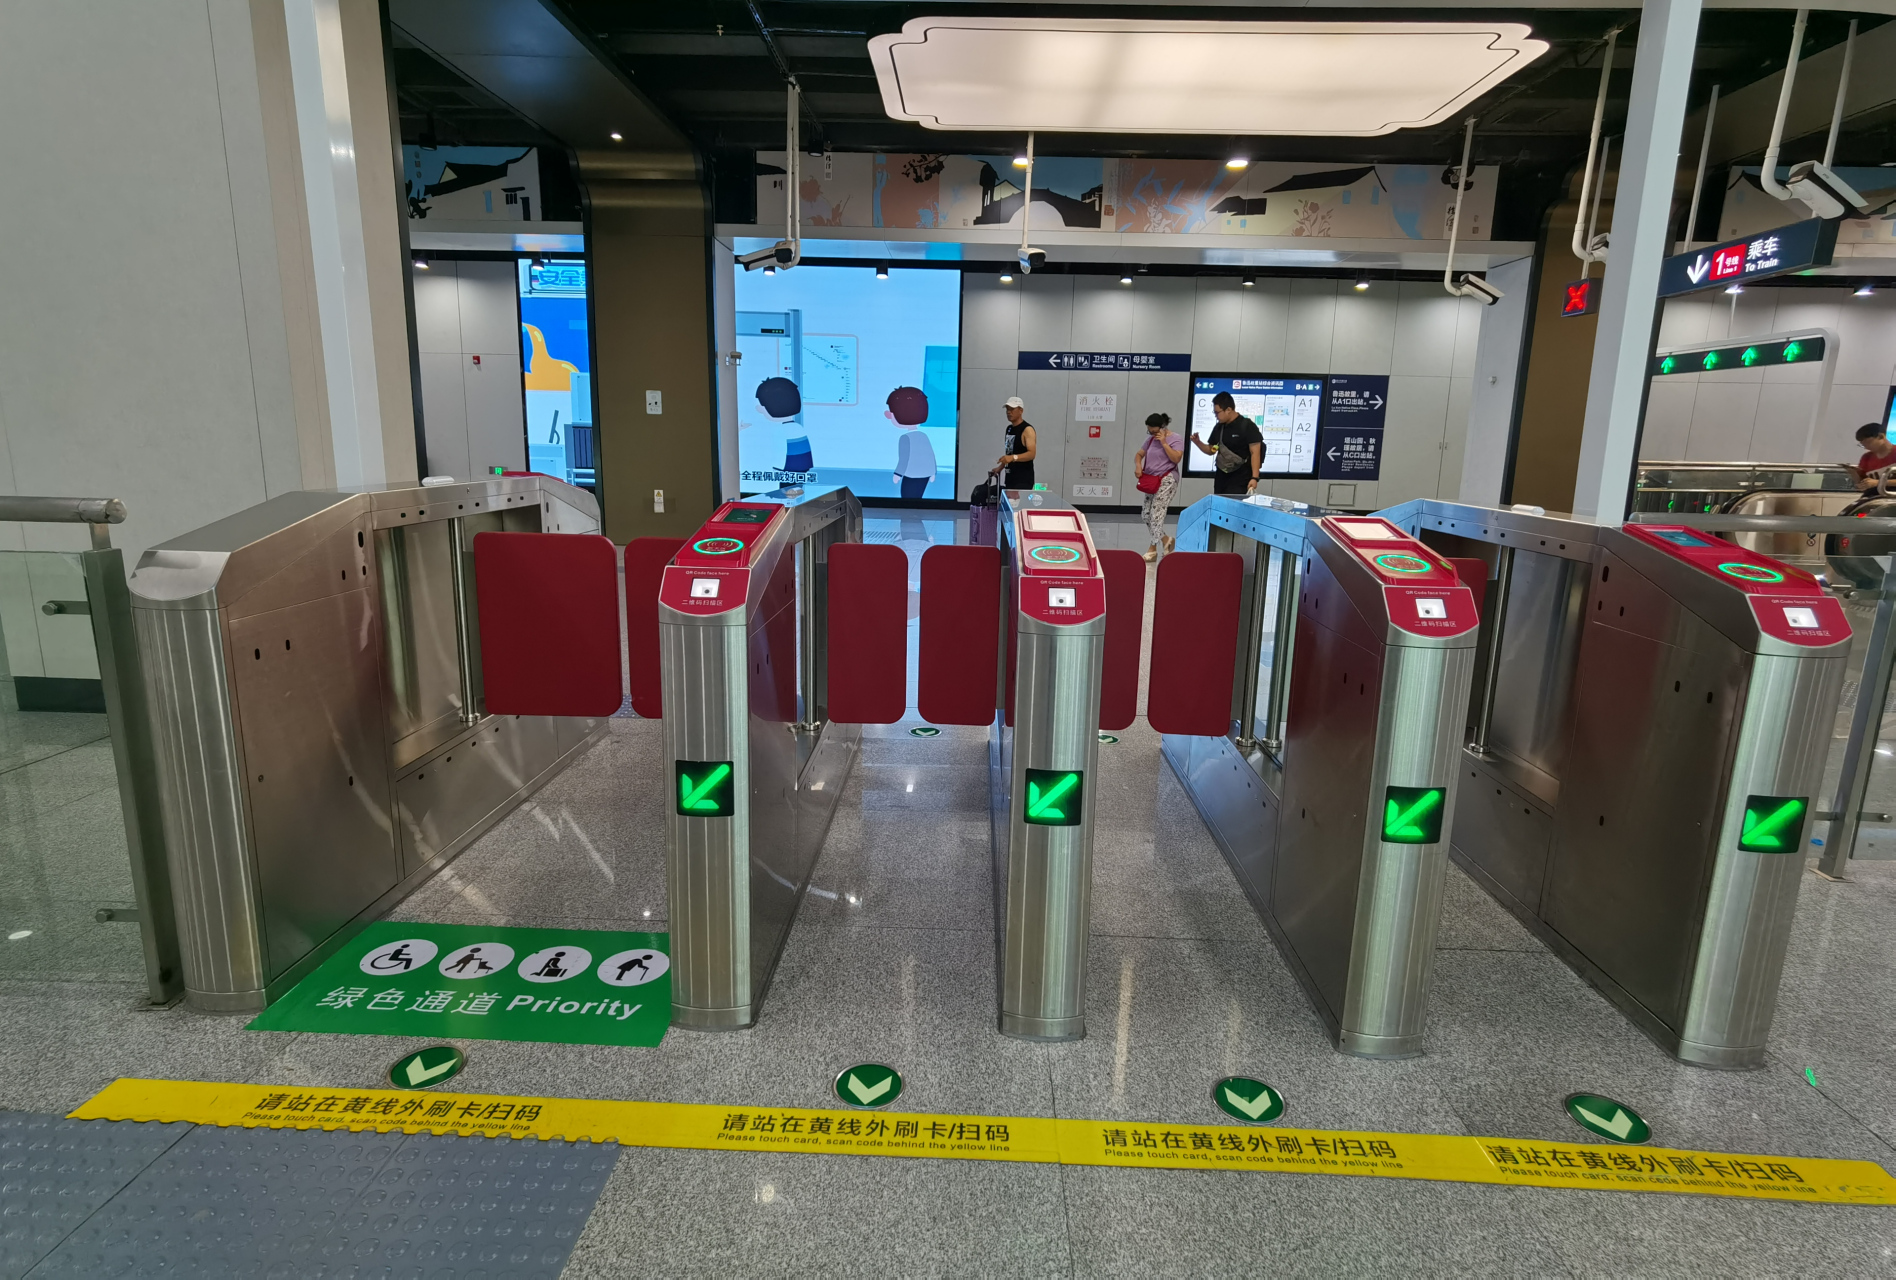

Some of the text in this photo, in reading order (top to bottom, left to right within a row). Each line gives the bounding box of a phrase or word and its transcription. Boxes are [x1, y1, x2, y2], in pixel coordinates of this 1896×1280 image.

[1746, 236, 1779, 260] 乘车
[1745, 258, 1779, 272] To Train
[1092, 354, 1115, 364] 卫生间
[1133, 355, 1155, 364] 母婴室
[1198, 398, 1206, 408] C
[1298, 399, 1313, 407] A1
[1296, 423, 1311, 431] A2
[1294, 445, 1302, 453] B
[741, 470, 818, 483] 全程佩戴好口罩
[1076, 487, 1109, 496] 灭火器
[316, 985, 643, 1020] 绿色通道 Priority
[254, 1092, 543, 1122] 请站在黄线外刷卡/扫码
[242, 1112, 281, 1120] Please
[284, 1114, 315, 1122] touch
[318, 1115, 345, 1123] card,
[410, 1119, 448, 1127] behind
[471, 1122, 508, 1130] yellow
[510, 1123, 530, 1131] line
[722, 1113, 1009, 1142] 请站在黄线外刷卡/扫码
[717, 1132, 755, 1141] Please
[760, 1135, 789, 1143] touch
[794, 1137, 821, 1145] card,
[887, 1140, 925, 1148] behind
[951, 1143, 986, 1151] yellow
[990, 1144, 1010, 1152] line
[1102, 1129, 1397, 1159] 请站在黄线外刷卡/扫码
[1105, 1149, 1144, 1157] Please
[1148, 1150, 1178, 1159] touch
[1183, 1152, 1212, 1161] card,
[1216, 1154, 1243, 1162] scan
[1277, 1156, 1316, 1164] behind
[1341, 1159, 1377, 1167] yellow
[1381, 1161, 1403, 1169] line
[1486, 1144, 1805, 1183] 请站在黄线外刷卡/扫码
[1499, 1166, 1542, 1176] Please
[1545, 1169, 1579, 1178] touch
[1618, 1174, 1646, 1183] scan
[1681, 1178, 1725, 1188] behind
[1727, 1181, 1748, 1189] the
[1751, 1182, 1789, 1192] yellow
[1793, 1185, 1817, 1194] line
